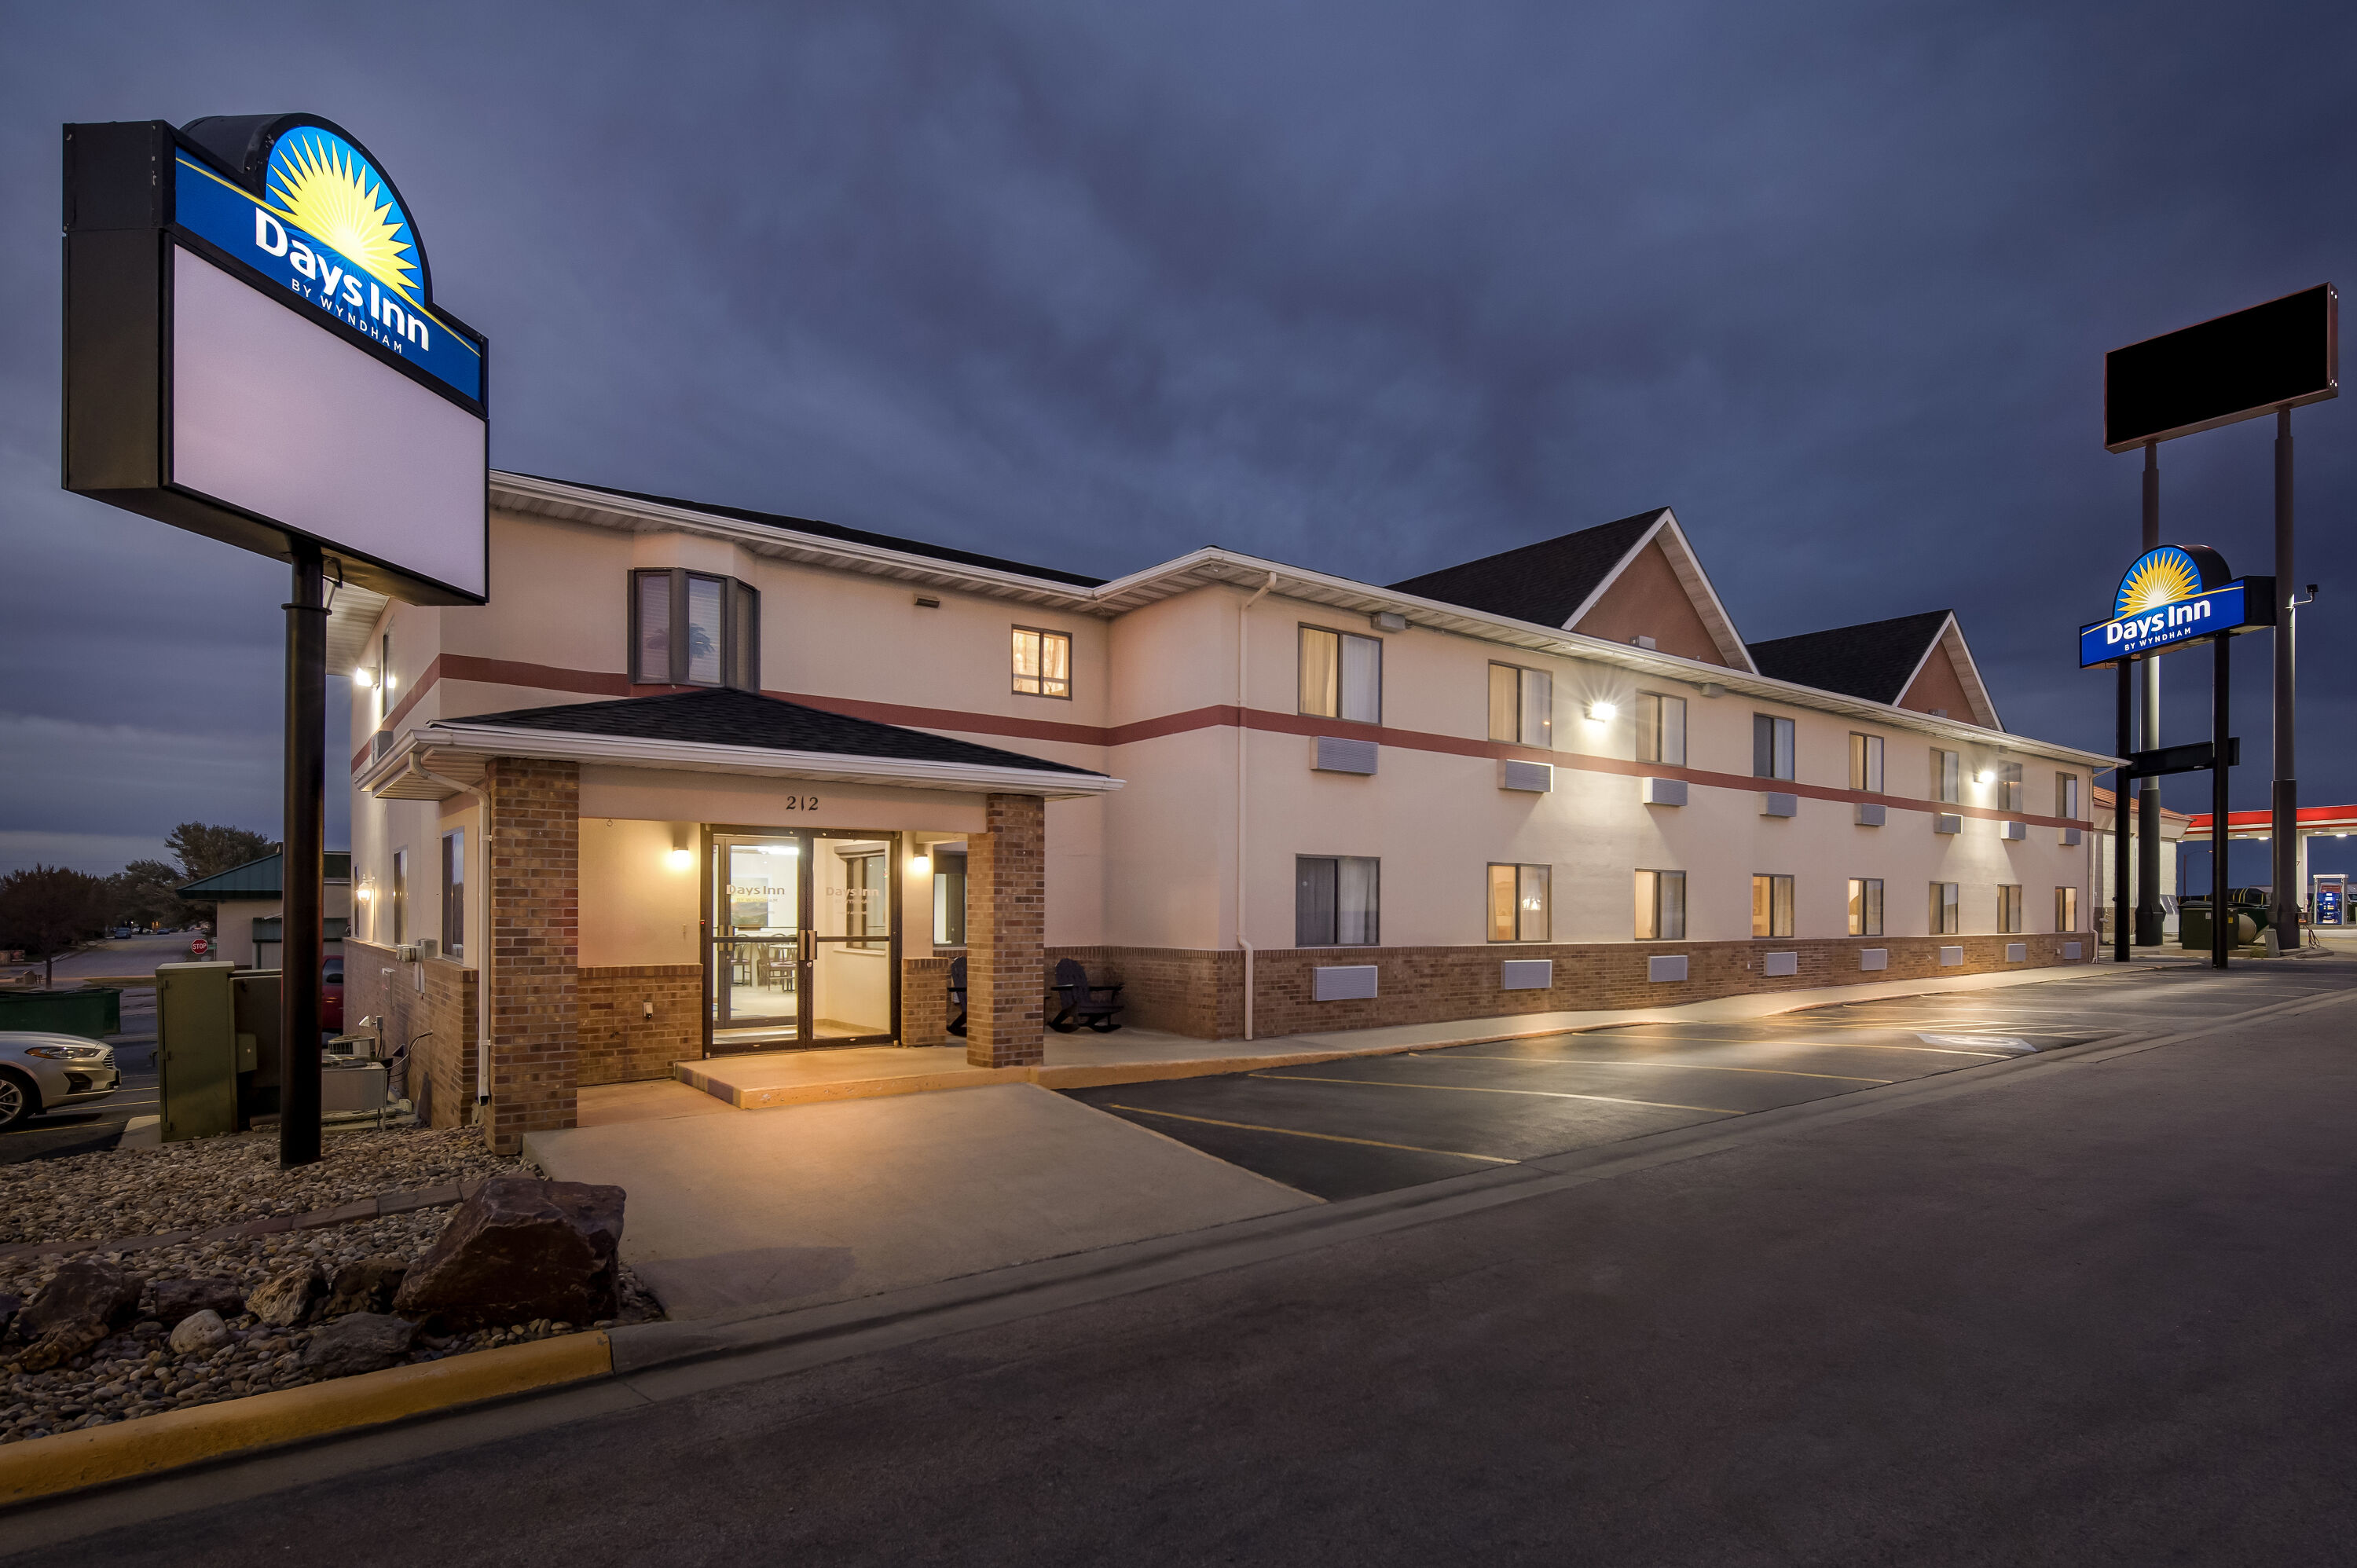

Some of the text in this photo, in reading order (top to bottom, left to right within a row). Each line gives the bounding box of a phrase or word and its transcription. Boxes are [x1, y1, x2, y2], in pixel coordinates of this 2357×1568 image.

[255, 207, 430, 352] Days Inn
[291, 278, 402, 354] BY WYNDHAM
[2106, 599, 2211, 645] Days Inn
[2124, 627, 2191, 651] BY WYNDHAM
[786, 795, 819, 811] 212
[726, 884, 785, 896] Days Inn
